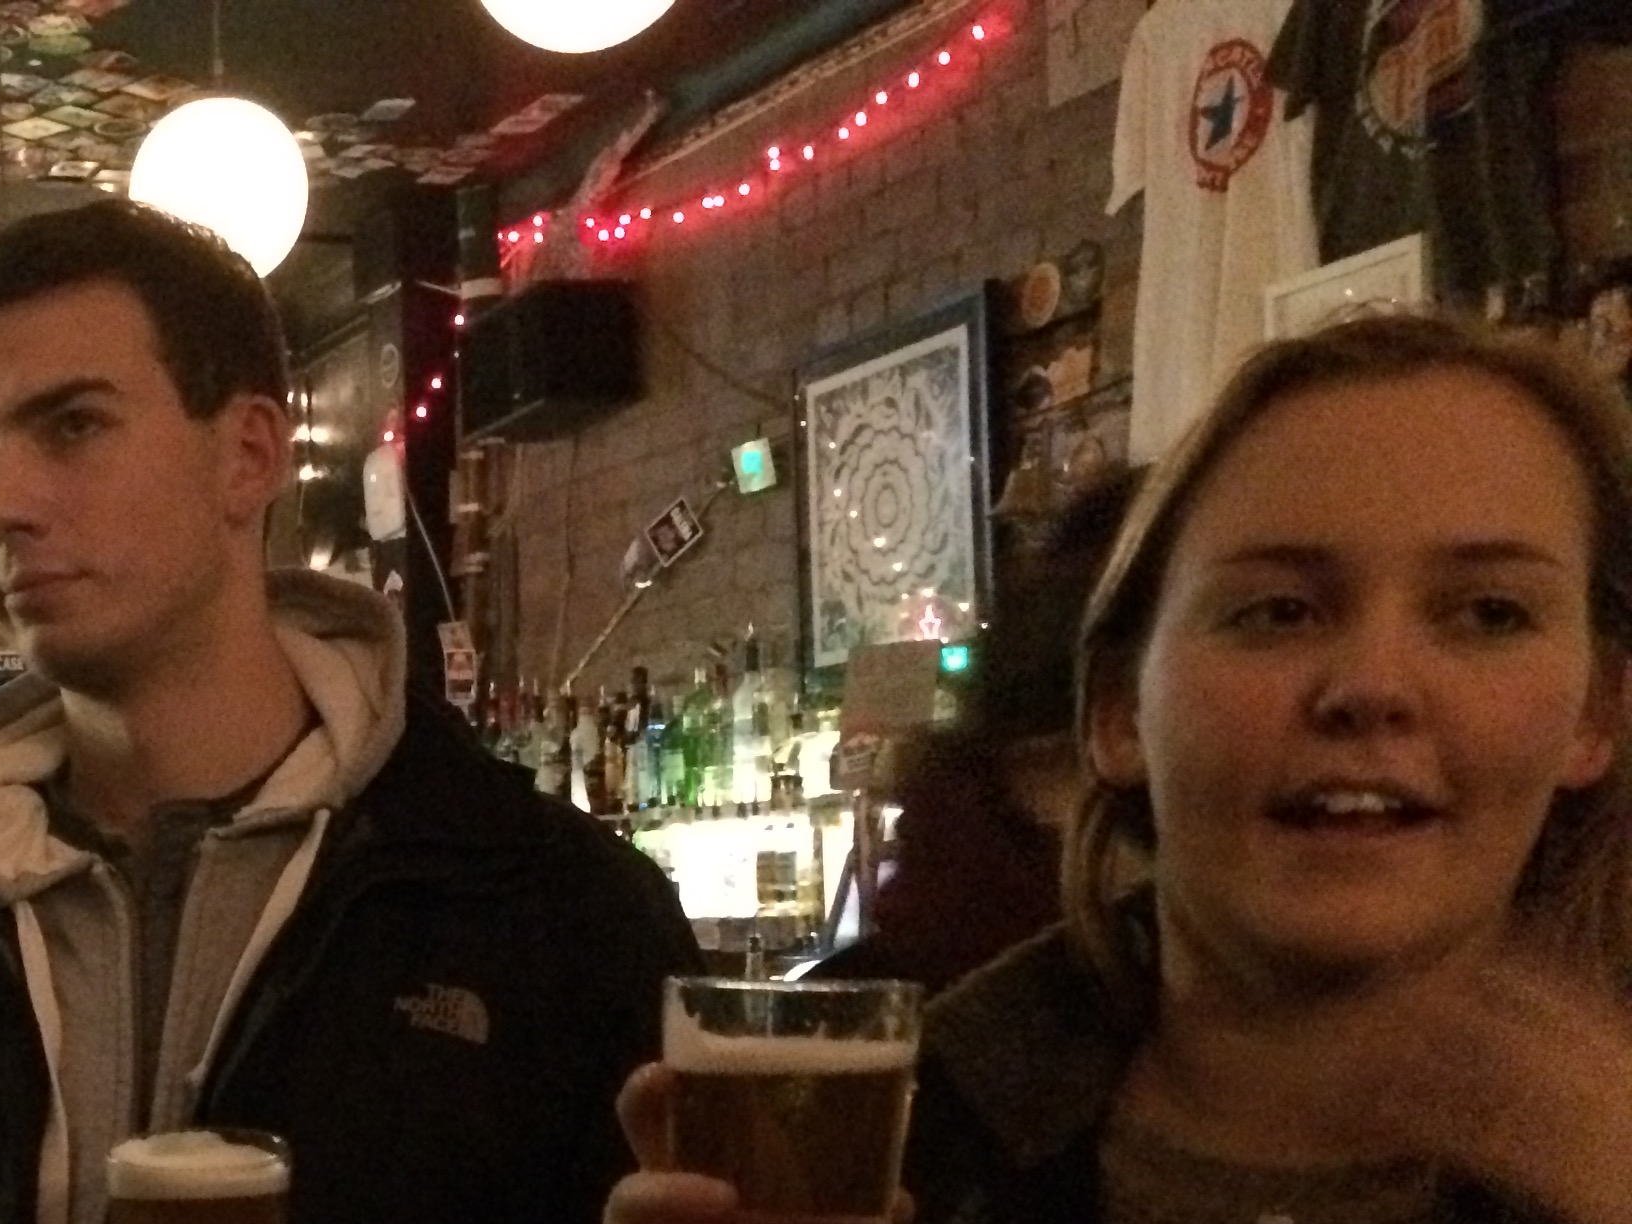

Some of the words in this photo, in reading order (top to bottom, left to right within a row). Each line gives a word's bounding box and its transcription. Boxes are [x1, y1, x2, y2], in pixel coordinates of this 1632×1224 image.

[425, 982, 464, 1003] THE
[392, 996, 460, 1018] NORTH
[409, 1012, 459, 1035] FACE
